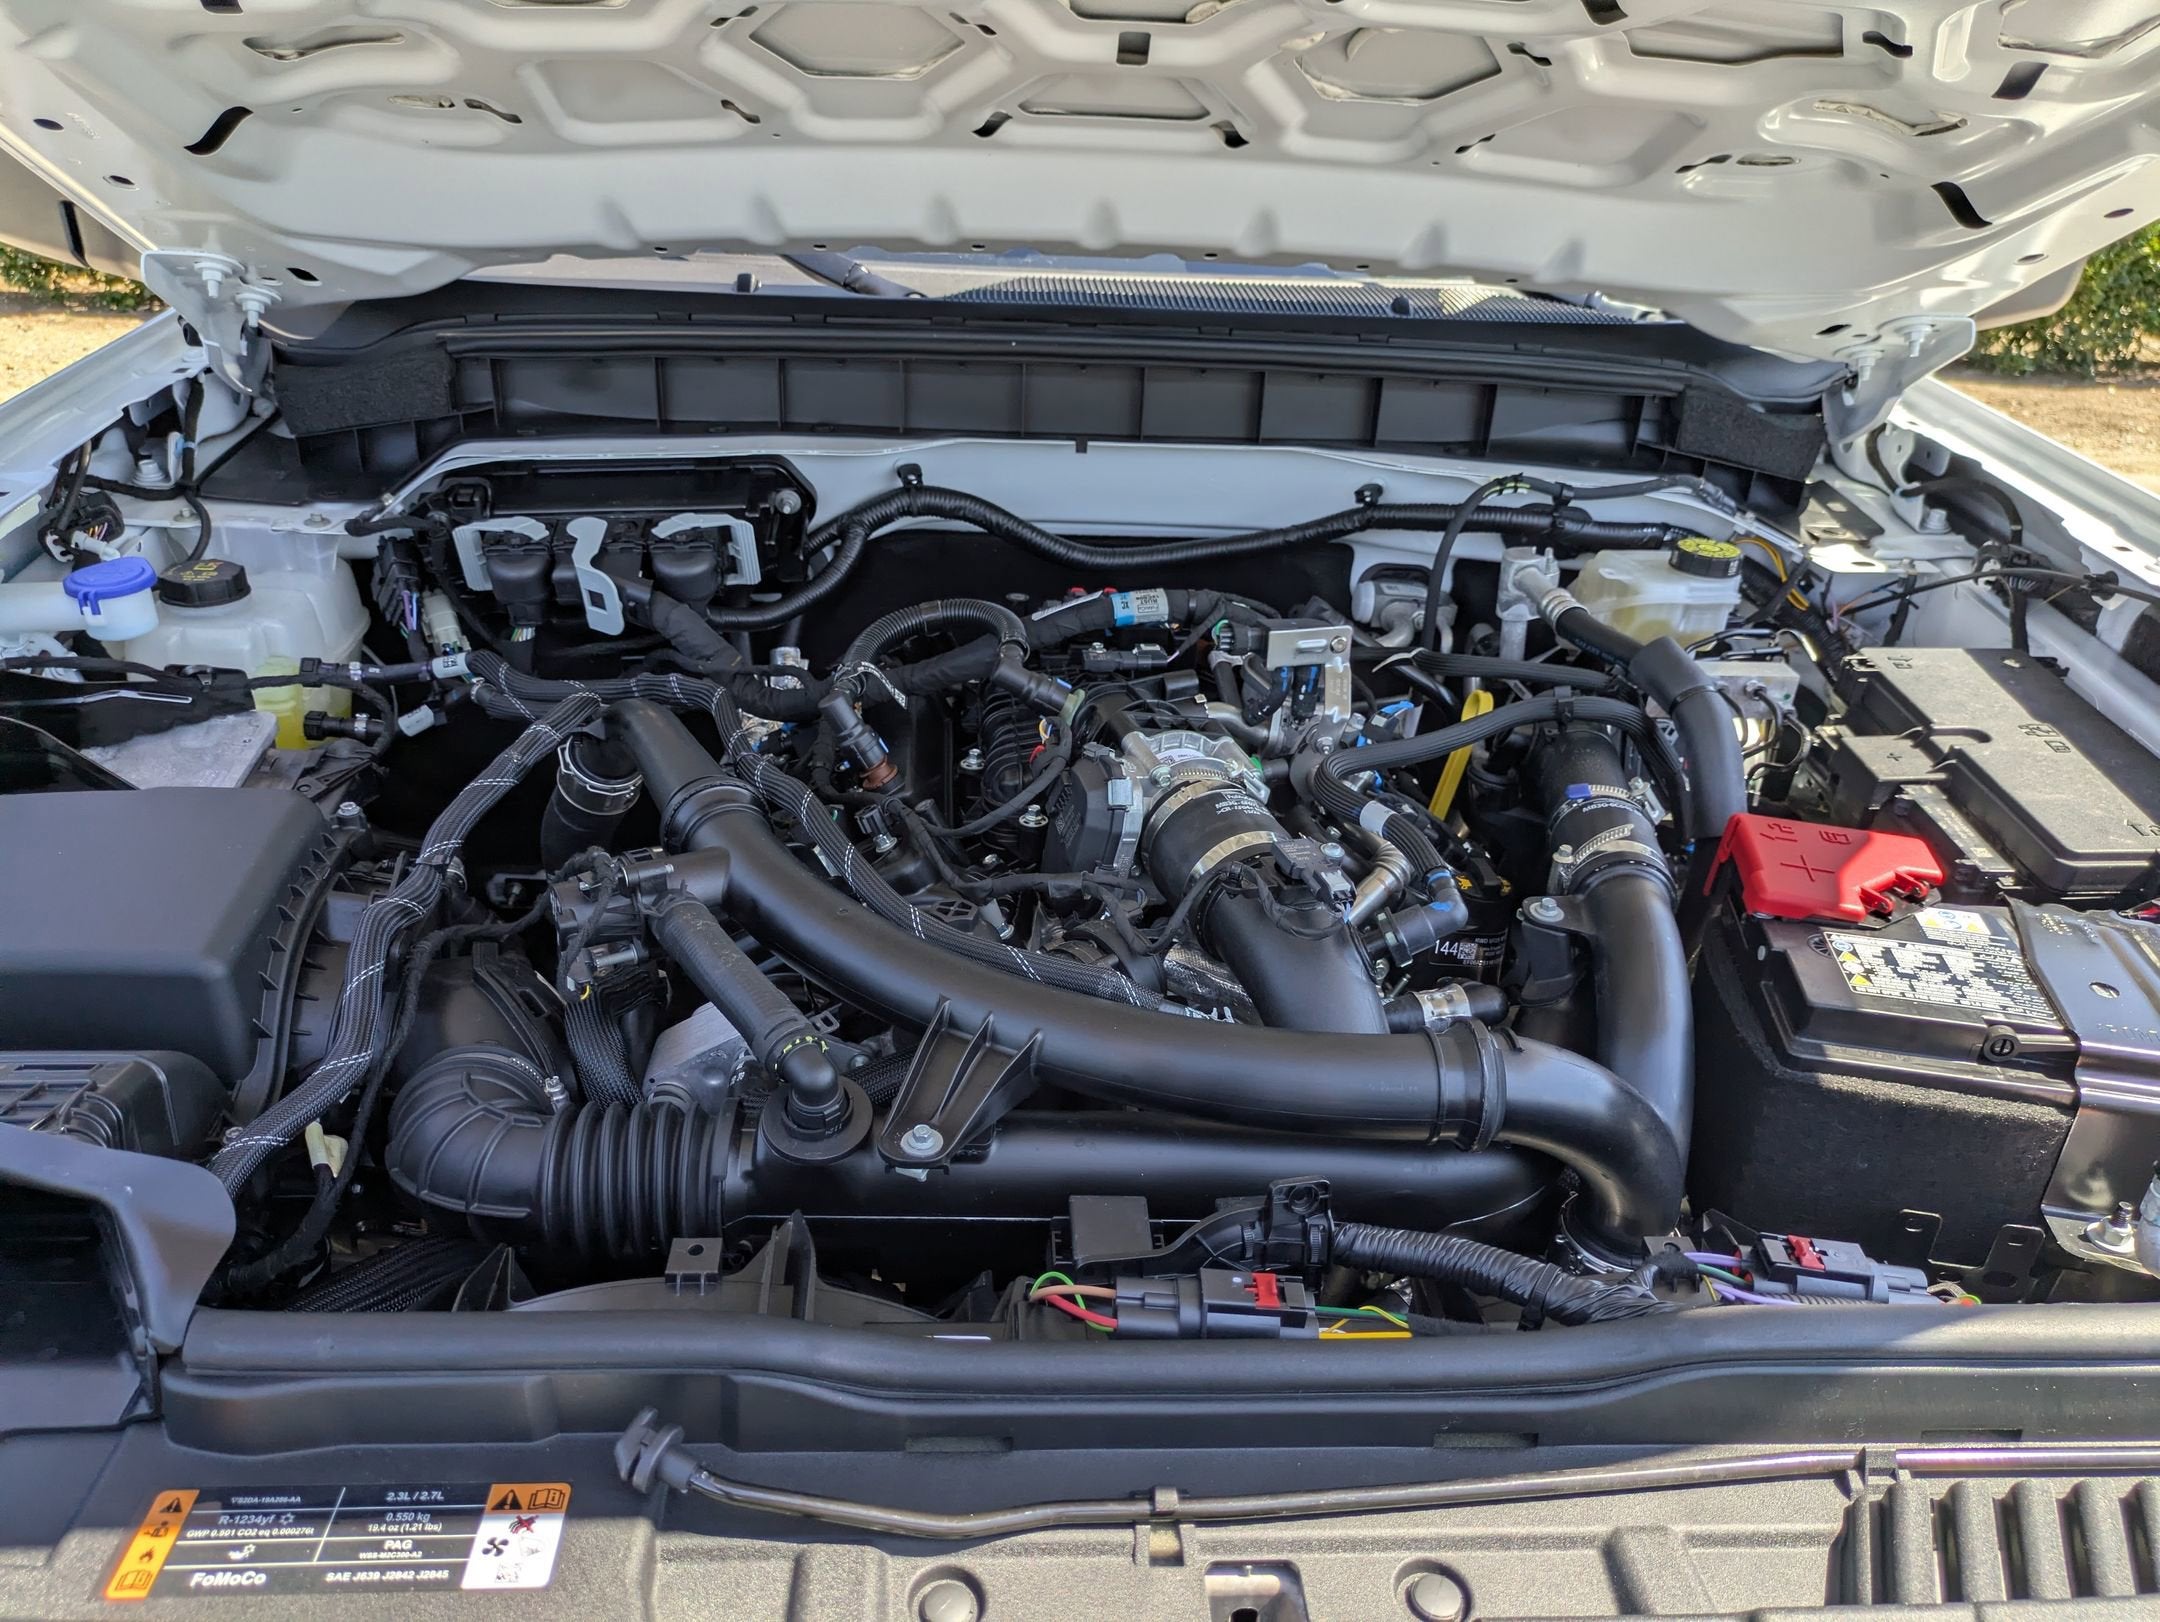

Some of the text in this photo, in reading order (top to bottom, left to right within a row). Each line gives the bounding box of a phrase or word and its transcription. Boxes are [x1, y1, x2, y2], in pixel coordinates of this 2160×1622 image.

[1434, 939, 1459, 956] 144
[386, 1491, 411, 1501] 2.3L
[419, 1491, 444, 1501] 2.7L
[218, 1513, 277, 1526] R-1234yf
[386, 1512, 431, 1522] 0.550 kg
[387, 1524, 400, 1532] oz
[384, 1539, 413, 1550] PAG
[190, 1571, 267, 1587] FoMoCo
[325, 1572, 352, 1583] SAE
[352, 1571, 381, 1582] J639
